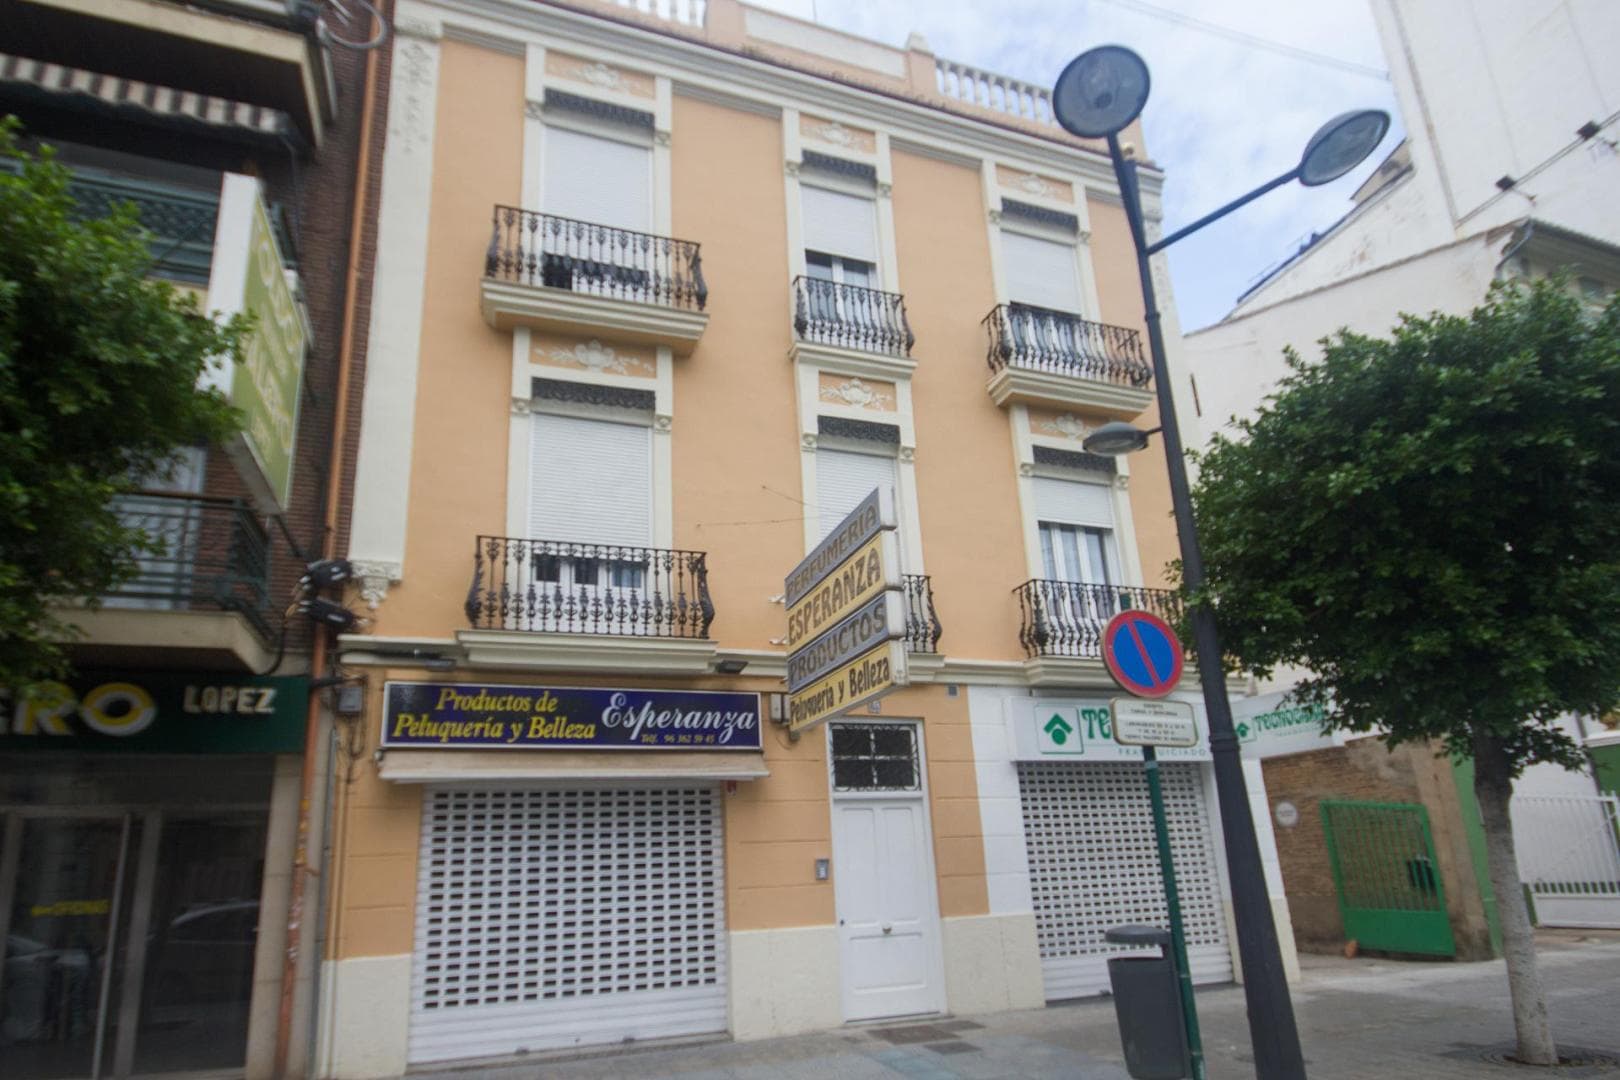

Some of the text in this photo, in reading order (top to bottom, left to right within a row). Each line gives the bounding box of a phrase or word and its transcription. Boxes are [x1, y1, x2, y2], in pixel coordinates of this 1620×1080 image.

[788, 547, 881, 646] ESPERANZA
[789, 602, 887, 685] PRODUCTOS
[182, 684, 278, 714] LOPEZ
[436, 687, 559, 713] Productos de
[838, 679, 845, 703] y
[849, 655, 890, 698] Belleza
[392, 713, 597, 744] Peluquería y Belleza
[601, 692, 757, 744] Esperanza
